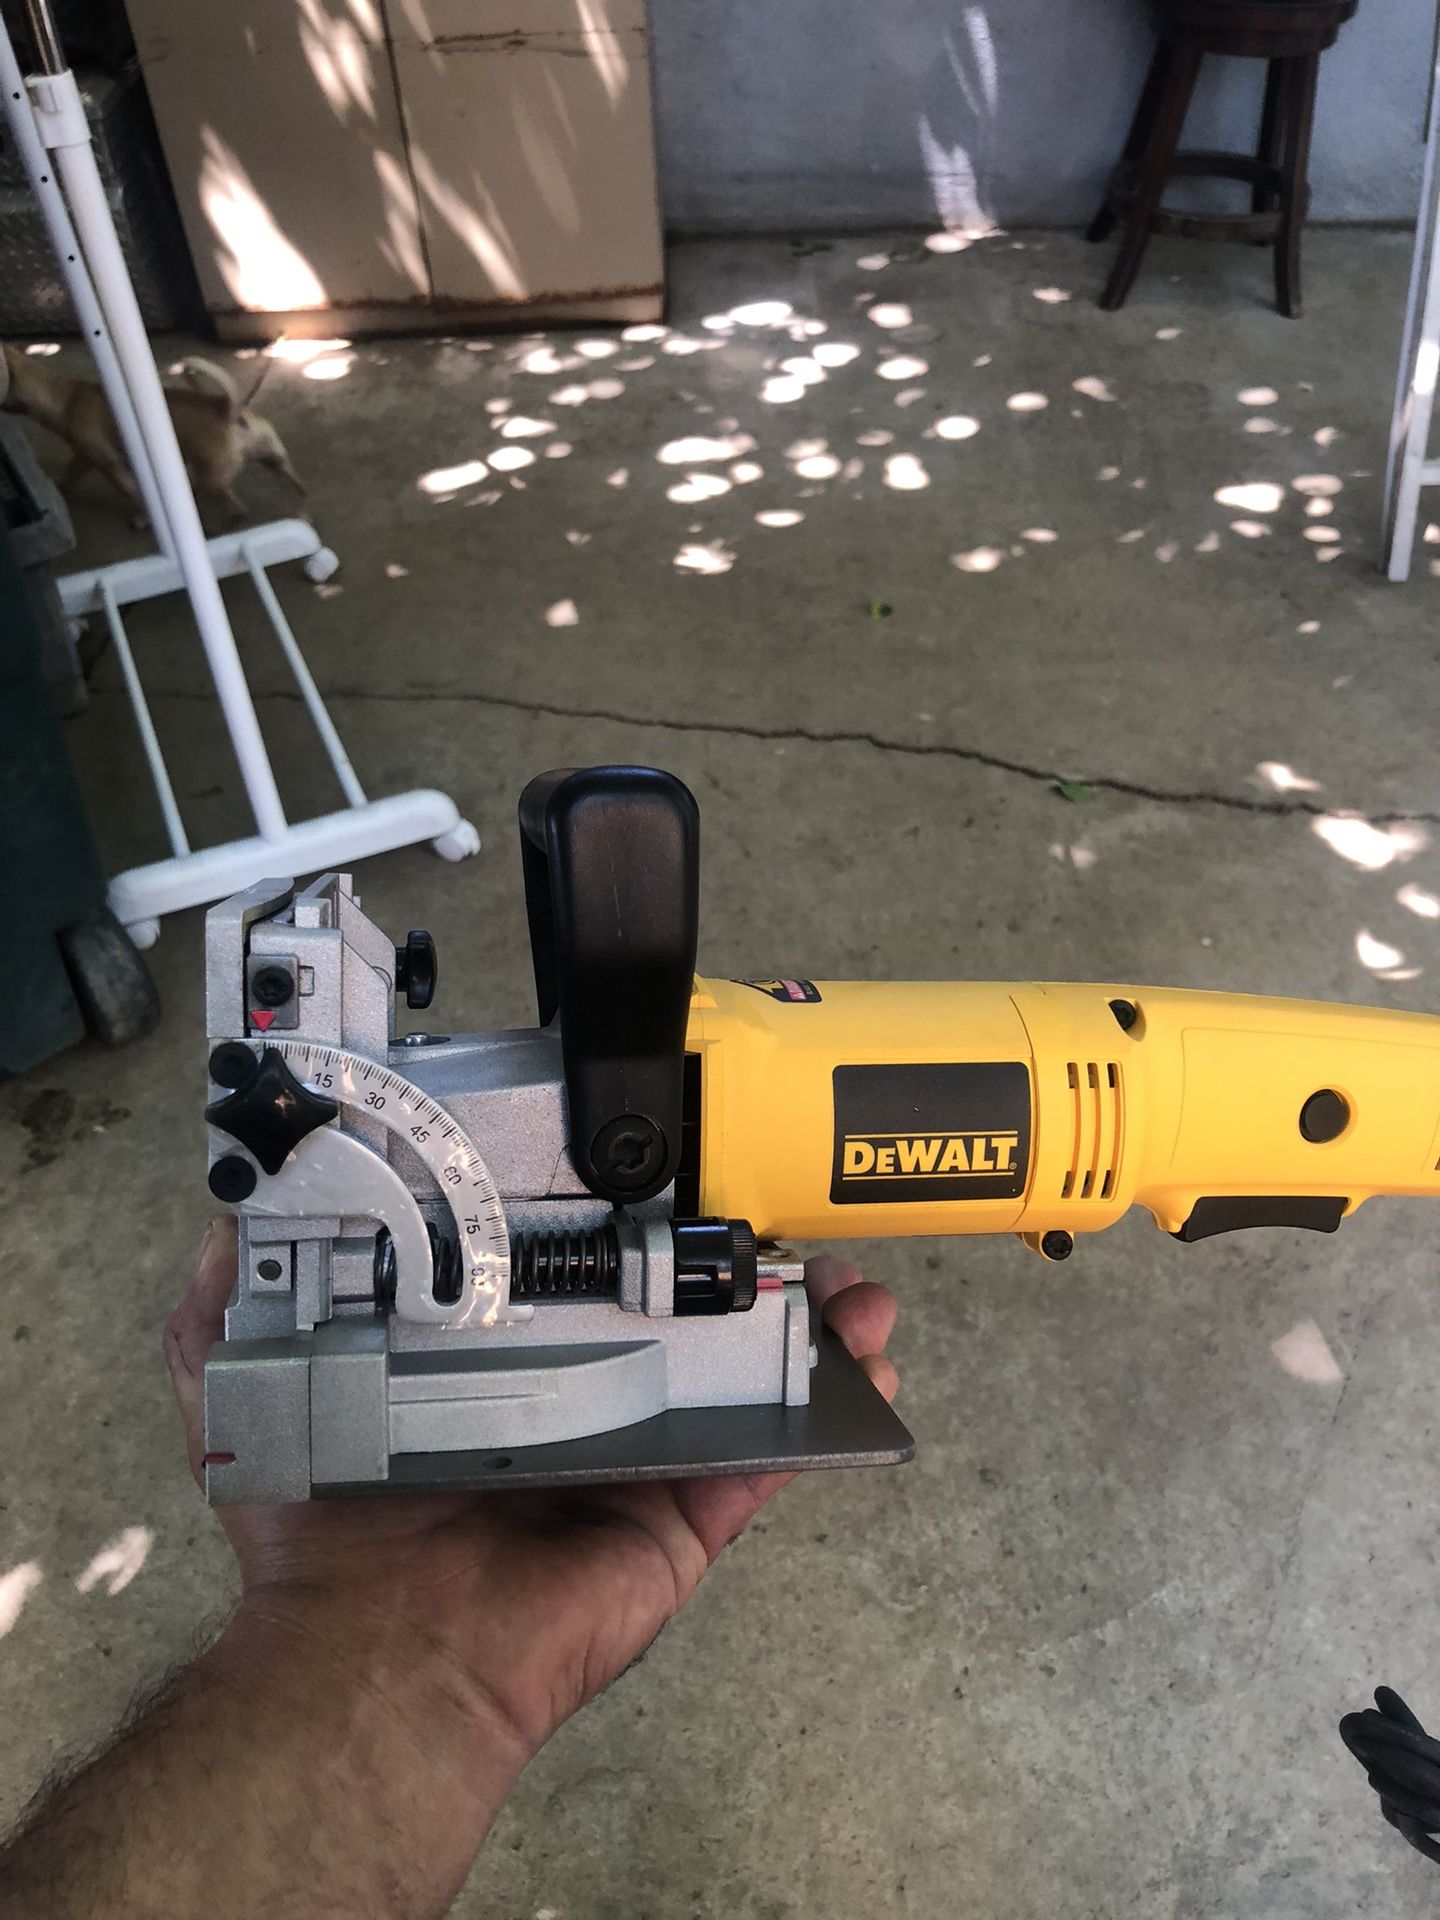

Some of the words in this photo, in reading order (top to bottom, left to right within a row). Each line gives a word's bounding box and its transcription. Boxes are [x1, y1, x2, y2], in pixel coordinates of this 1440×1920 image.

[313, 1071, 334, 1089] 15
[364, 1091, 386, 1110] 30
[410, 1125, 431, 1144] 45
[443, 1166, 462, 1185] 60
[464, 1215, 481, 1235] 75
